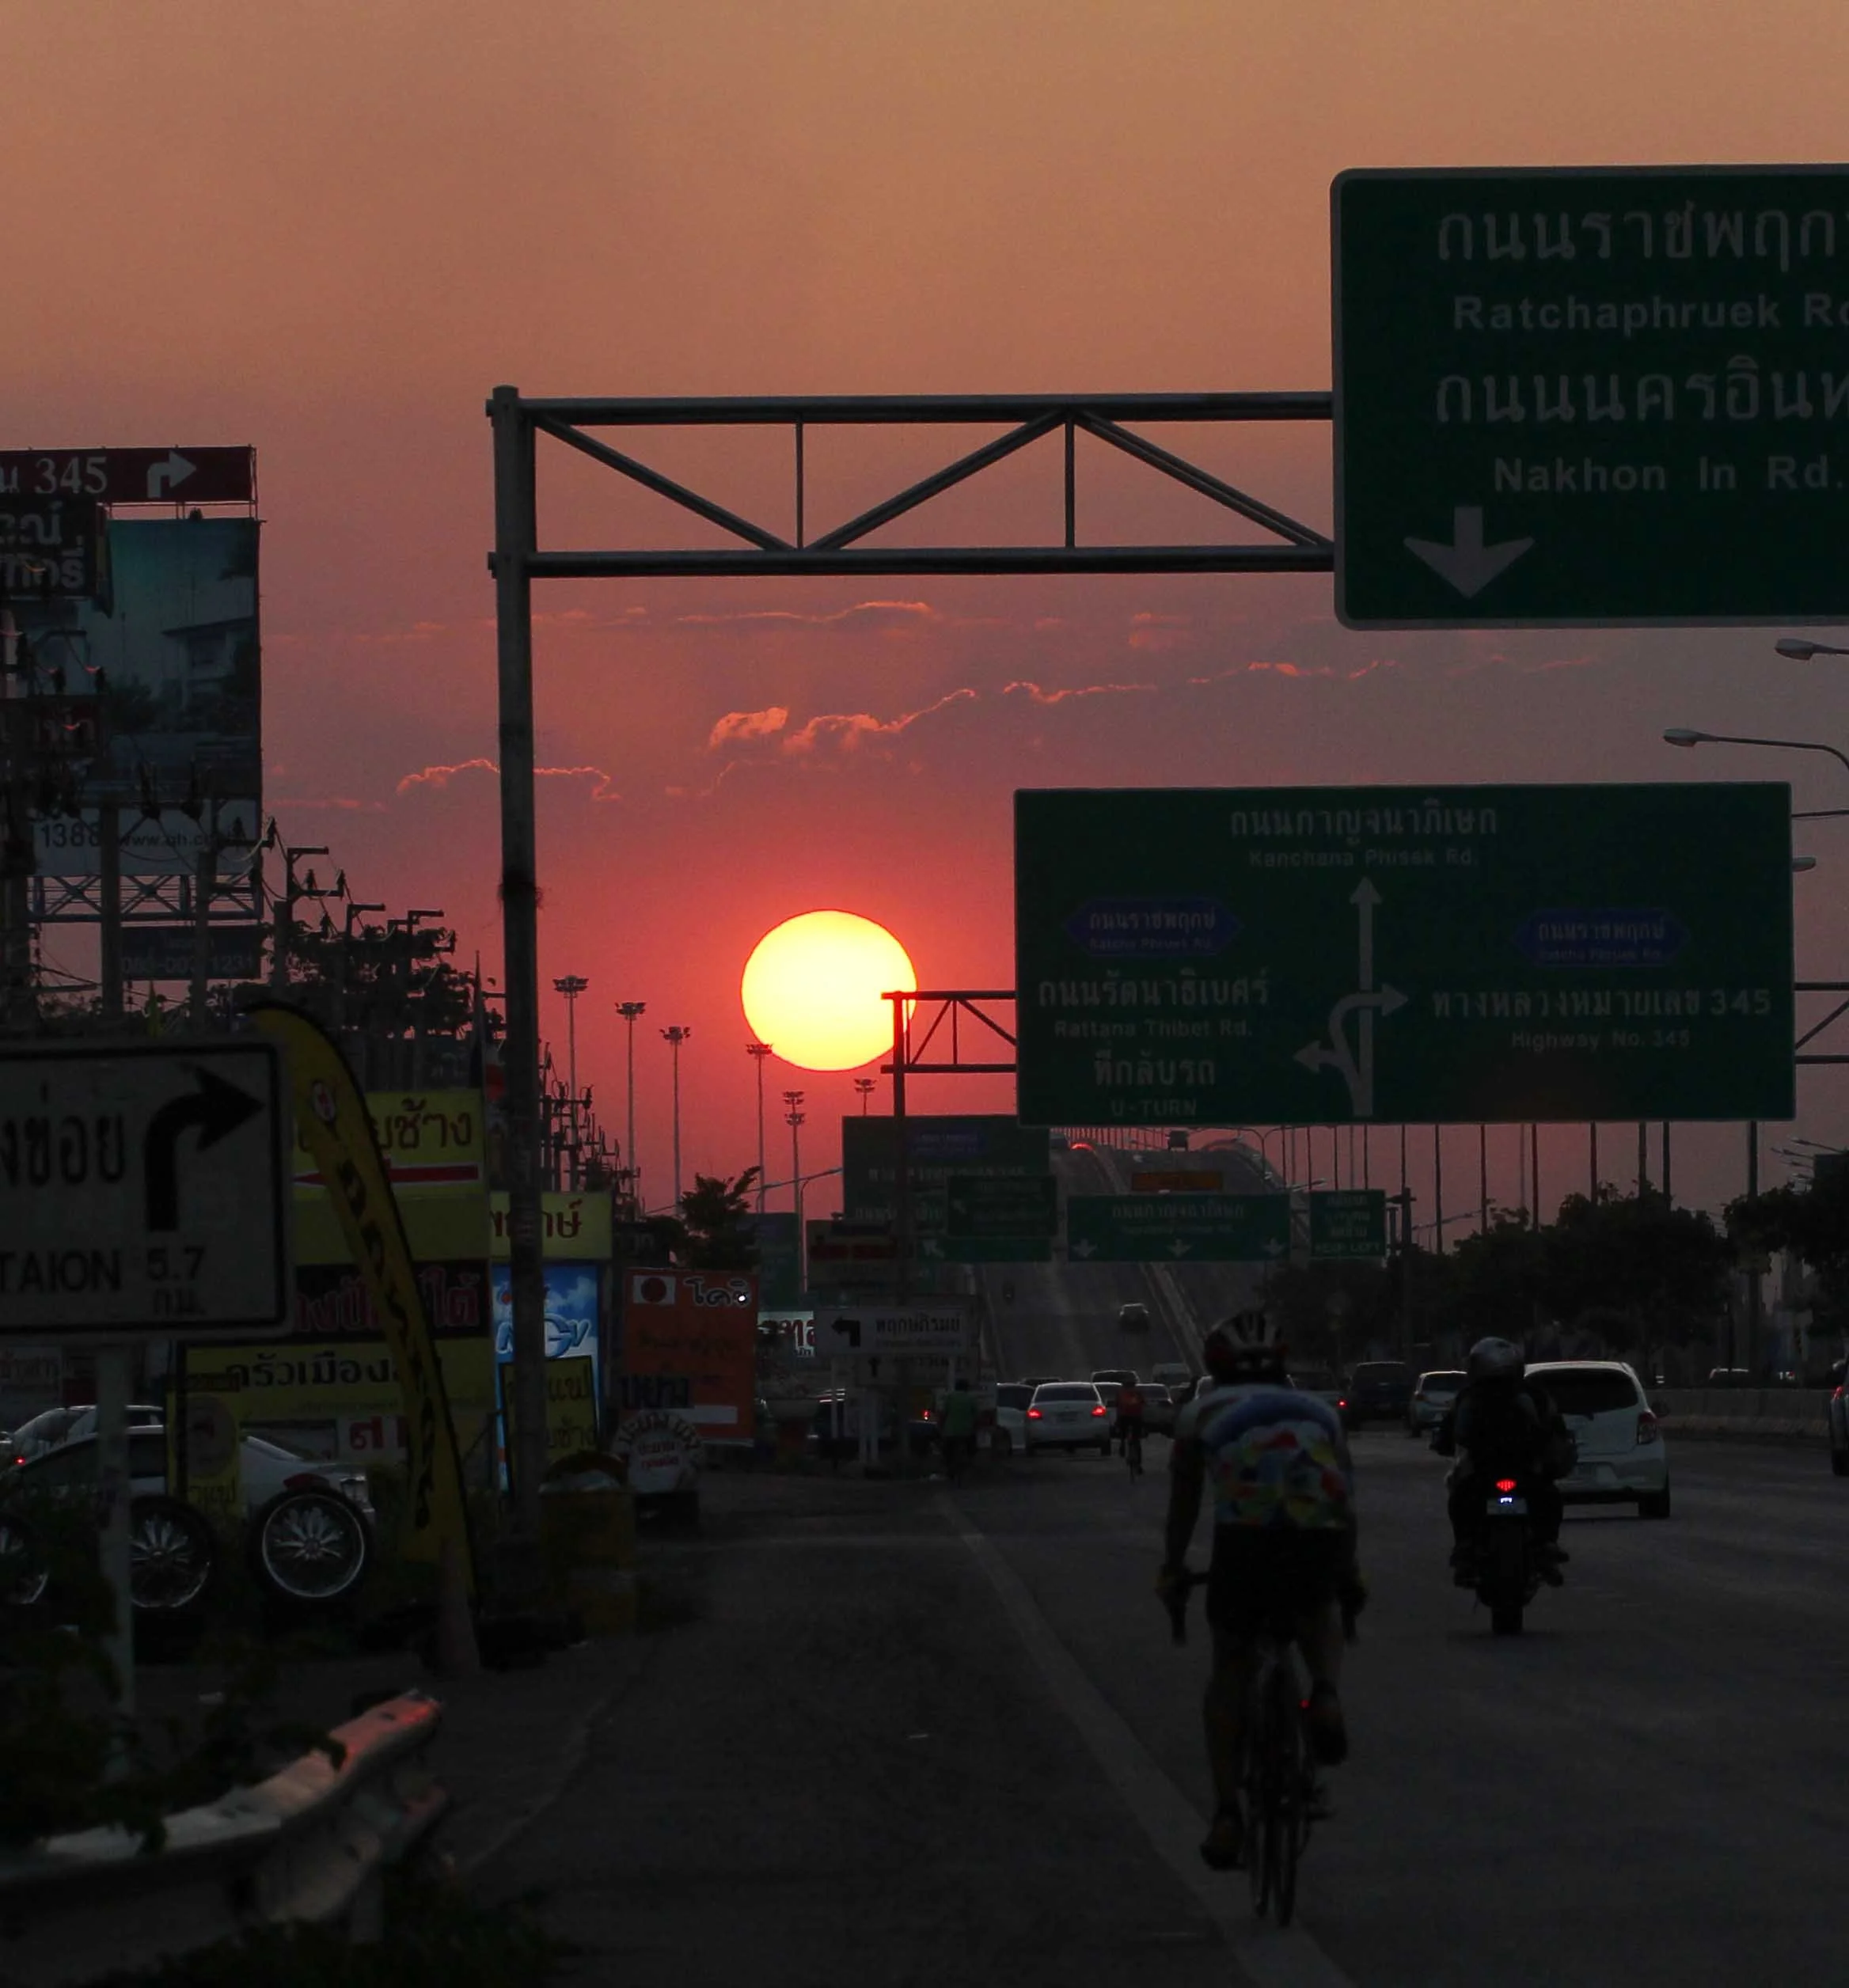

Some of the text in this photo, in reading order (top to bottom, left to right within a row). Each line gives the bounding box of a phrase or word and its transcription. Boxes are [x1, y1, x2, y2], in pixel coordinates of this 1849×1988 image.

[1437, 200, 1849, 272] ถนนราชพฤก
[1453, 294, 1781, 337] Ratchaphruek
[34, 456, 108, 495] 345
[1494, 453, 1845, 491] Nakhon In Rd.
[1249, 849, 1354, 868] Kanchana
[1709, 987, 1771, 1016] 345
[1054, 1019, 1136, 1038] Rattana
[1219, 1018, 1253, 1037] Rd.
[1511, 1030, 1600, 1053] Highway
[1612, 1030, 1646, 1048] No.
[1111, 1098, 1198, 1117] U-TURN
[146, 1246, 206, 1282] 5.7
